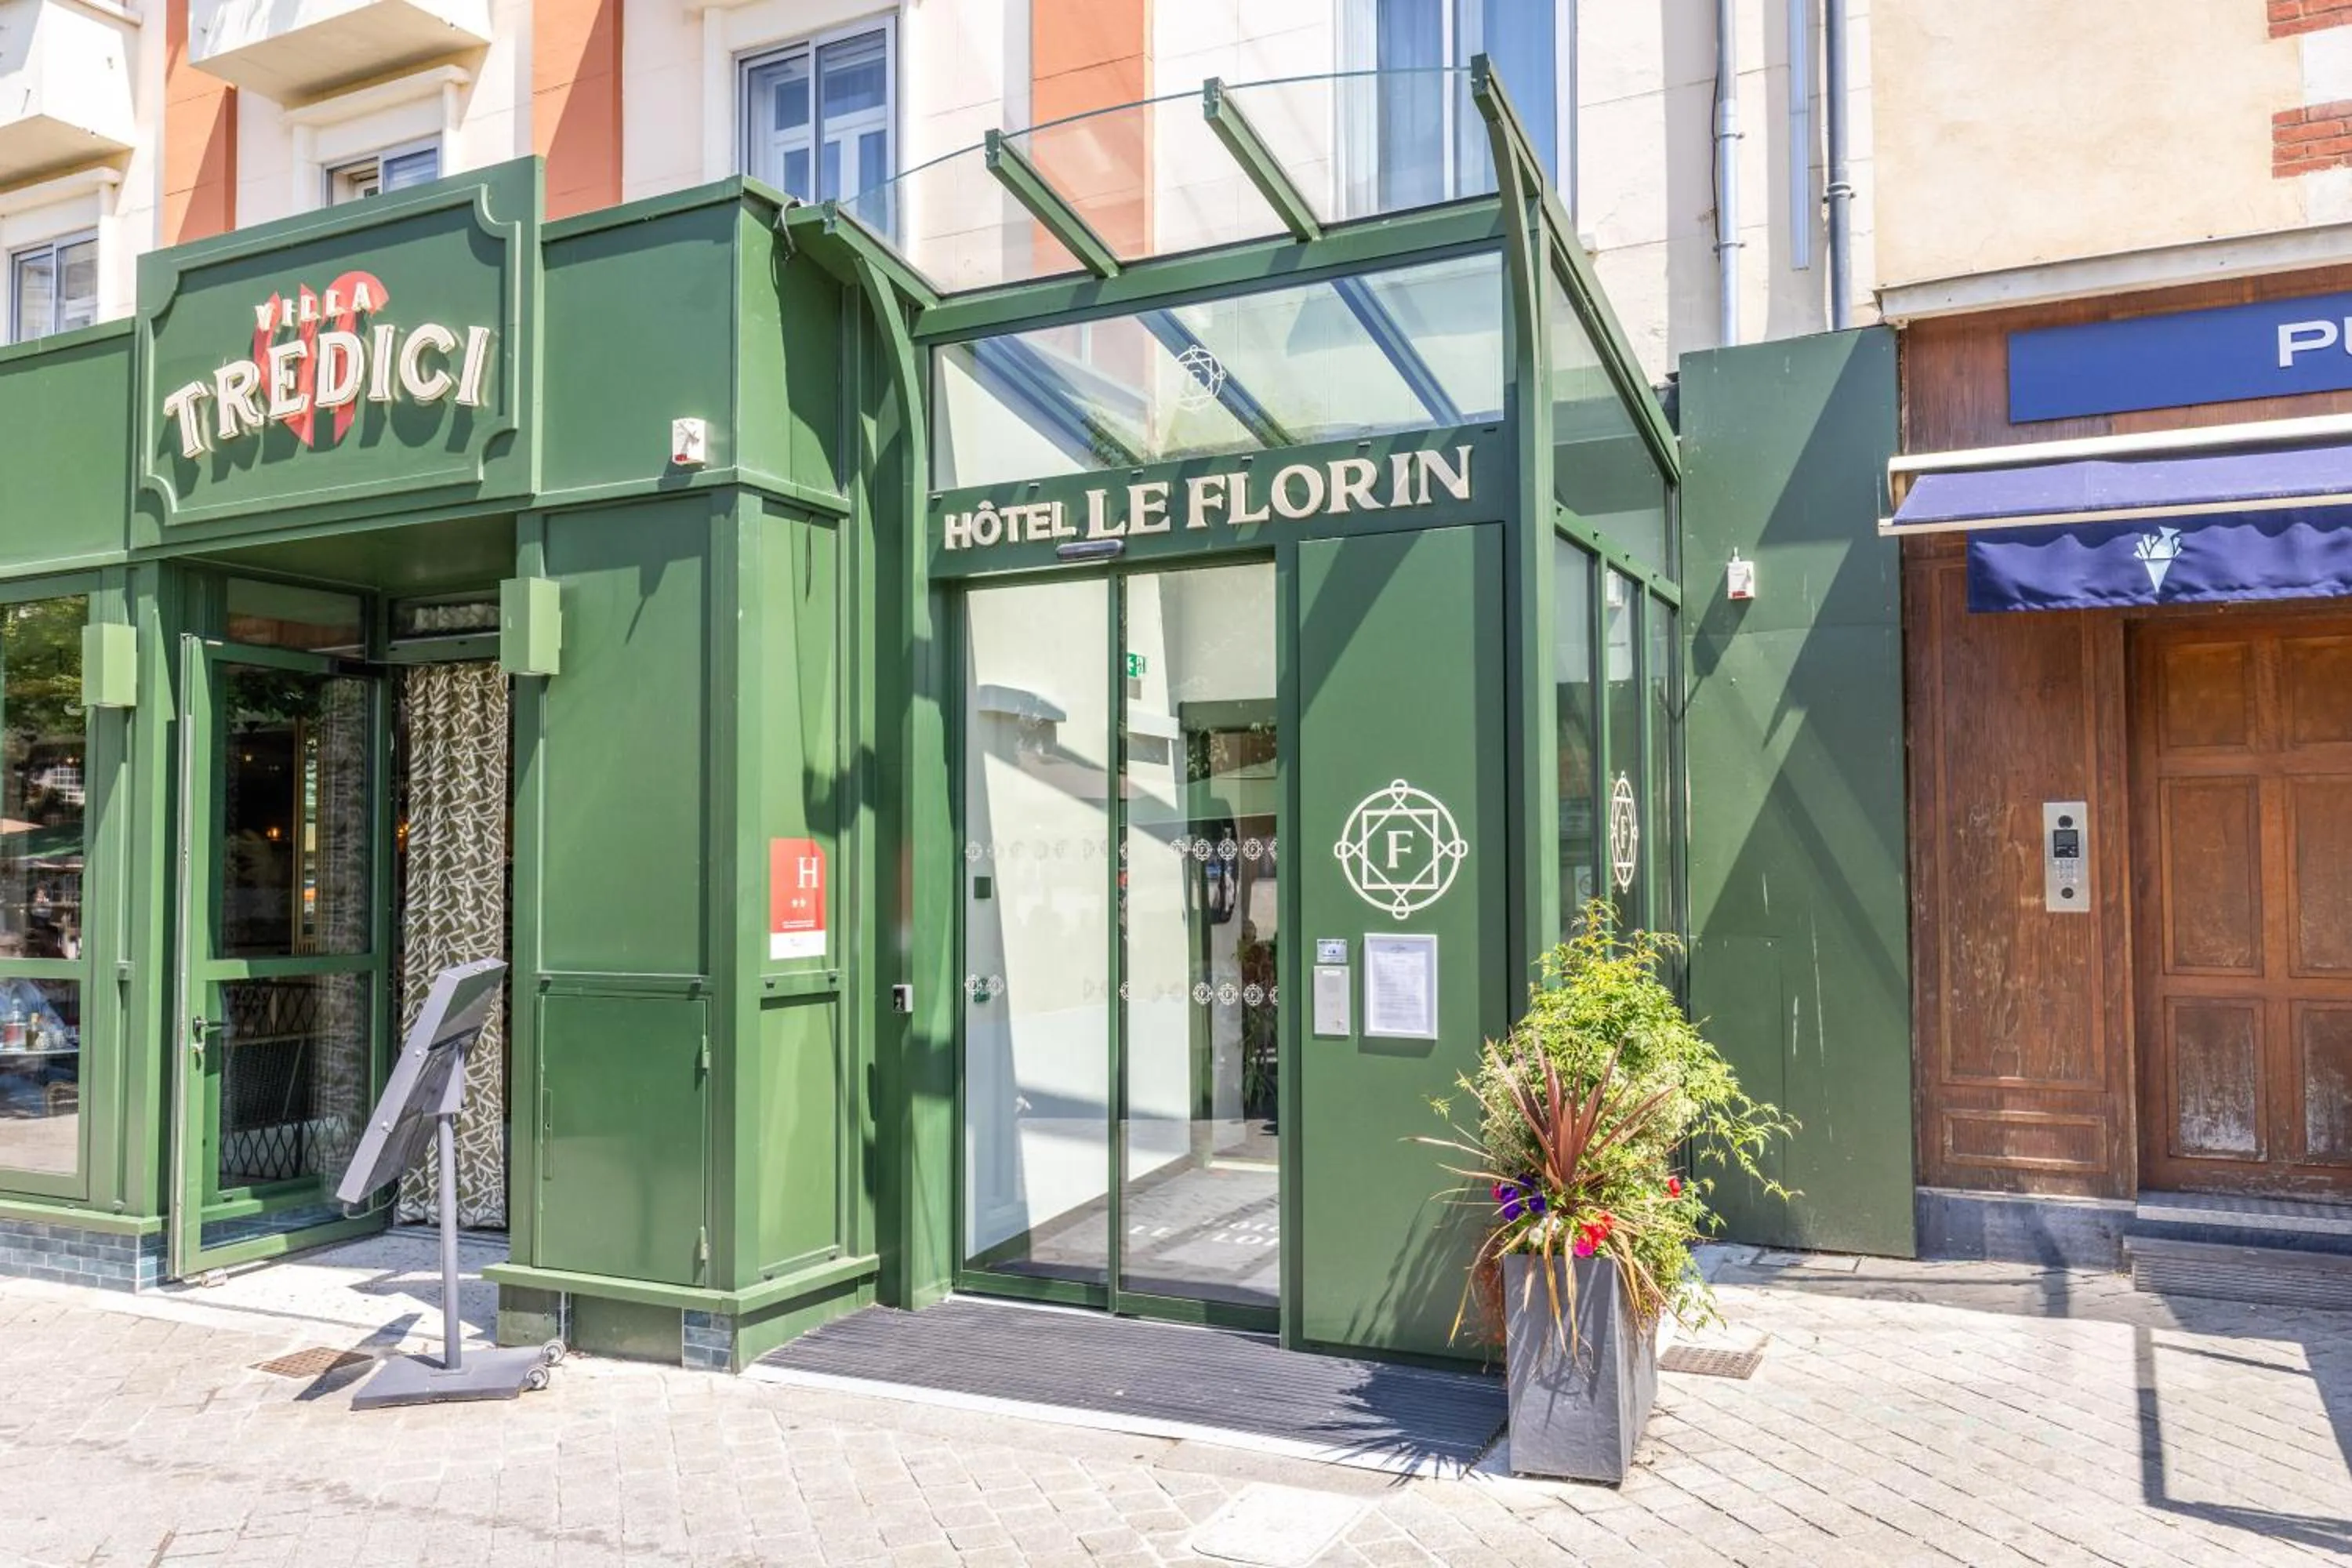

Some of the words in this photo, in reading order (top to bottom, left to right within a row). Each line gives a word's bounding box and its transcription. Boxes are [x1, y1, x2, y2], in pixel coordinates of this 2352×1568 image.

[254, 281, 373, 332] VILLA
[2278, 316, 2352, 368] P
[162, 322, 492, 459] TREDICI
[944, 499, 1077, 550] HÔTEL
[1086, 481, 1172, 539] LE
[1185, 445, 1474, 529] FLORIN
[796, 855, 820, 889] H
[1386, 829, 1414, 869] F
